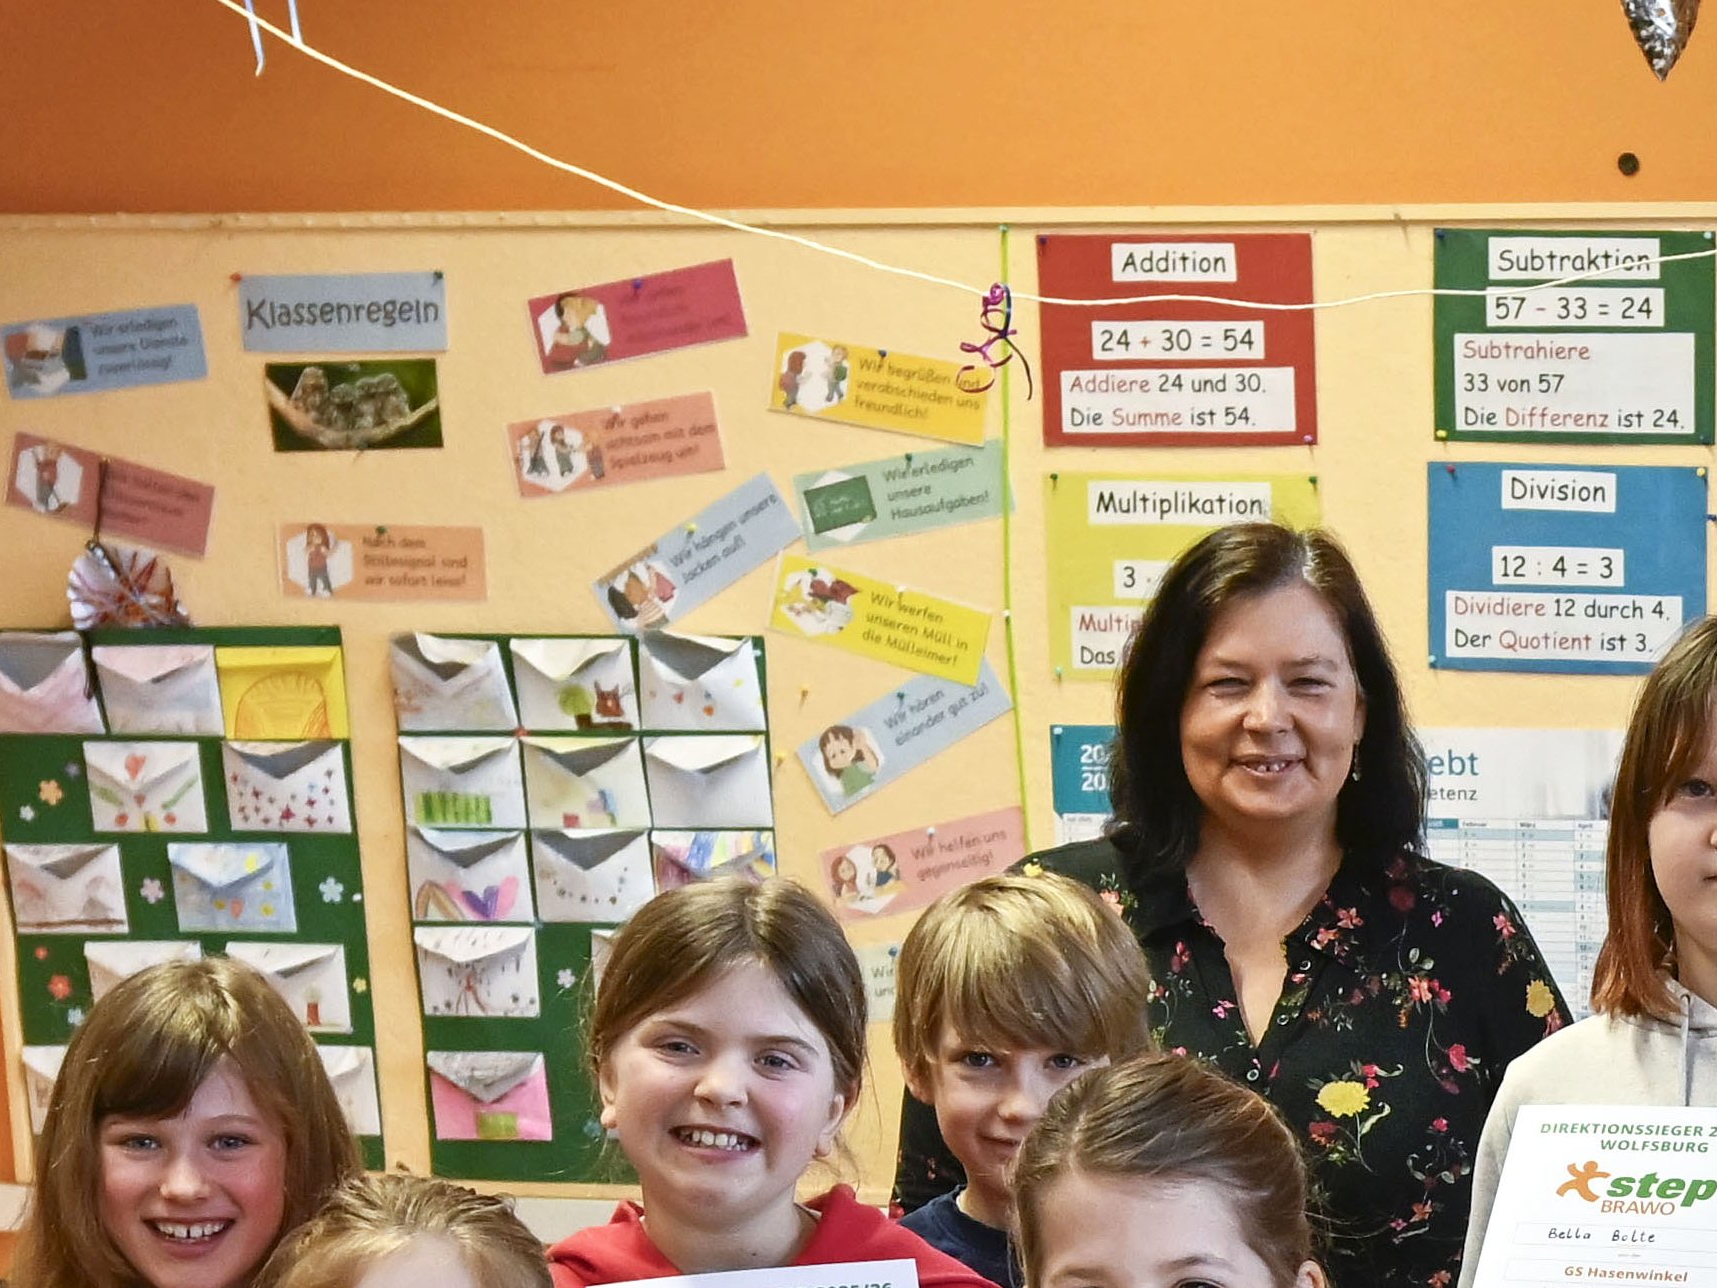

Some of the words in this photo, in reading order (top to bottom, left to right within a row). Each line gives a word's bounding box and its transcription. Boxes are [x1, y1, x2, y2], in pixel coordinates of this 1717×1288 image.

[1122, 250, 1227, 275] Addition
[1497, 249, 1650, 272] Subtraktion
[246, 298, 439, 329] Klassenregeln
[1495, 297, 1527, 321] 57
[1556, 297, 1588, 321] 33
[1598, 302, 1610, 316] =
[1621, 296, 1653, 321] 24
[1101, 328, 1131, 353] 24
[1138, 335, 1152, 348] +
[1161, 328, 1191, 353] 30
[1201, 335, 1213, 347] =
[1222, 328, 1254, 353] 54
[1463, 340, 1590, 360] Subtrahiere
[1071, 373, 1150, 393] Addiere
[1158, 373, 1183, 393] 24
[1191, 373, 1226, 393] und
[1234, 373, 1267, 393] 30.
[1463, 374, 1488, 393] 33
[1495, 377, 1529, 393] von
[1538, 374, 1564, 393] 57
[1071, 407, 1103, 427] Die
[1112, 407, 1183, 427] Summe
[1190, 407, 1216, 427] ist
[1223, 407, 1256, 427] 54.
[1465, 408, 1495, 428] Die
[1505, 408, 1610, 428] Differenz
[1617, 408, 1645, 428] ist
[1652, 408, 1684, 428] 24.
[1510, 478, 1606, 503] Division
[1095, 491, 1265, 518] Multiplikation
[1124, 567, 1136, 587] 3
[1501, 557, 1526, 578] 12
[1552, 557, 1567, 578] 4
[1576, 561, 1588, 575] =
[1600, 557, 1613, 579] 3
[872, 591, 894, 608] Wir
[1454, 598, 1546, 618] Dividiere
[1555, 600, 1575, 618] 12
[1583, 599, 1645, 619] durch
[1653, 600, 1670, 621] 4.
[863, 629, 882, 644] die
[957, 639, 969, 650] in
[1454, 631, 1490, 651] Der
[1499, 631, 1591, 653] Quotient
[1599, 632, 1625, 652] ist
[1635, 633, 1653, 653] 3.
[1080, 646, 1117, 665] Das
[1549, 1228, 1591, 1240] Bella
